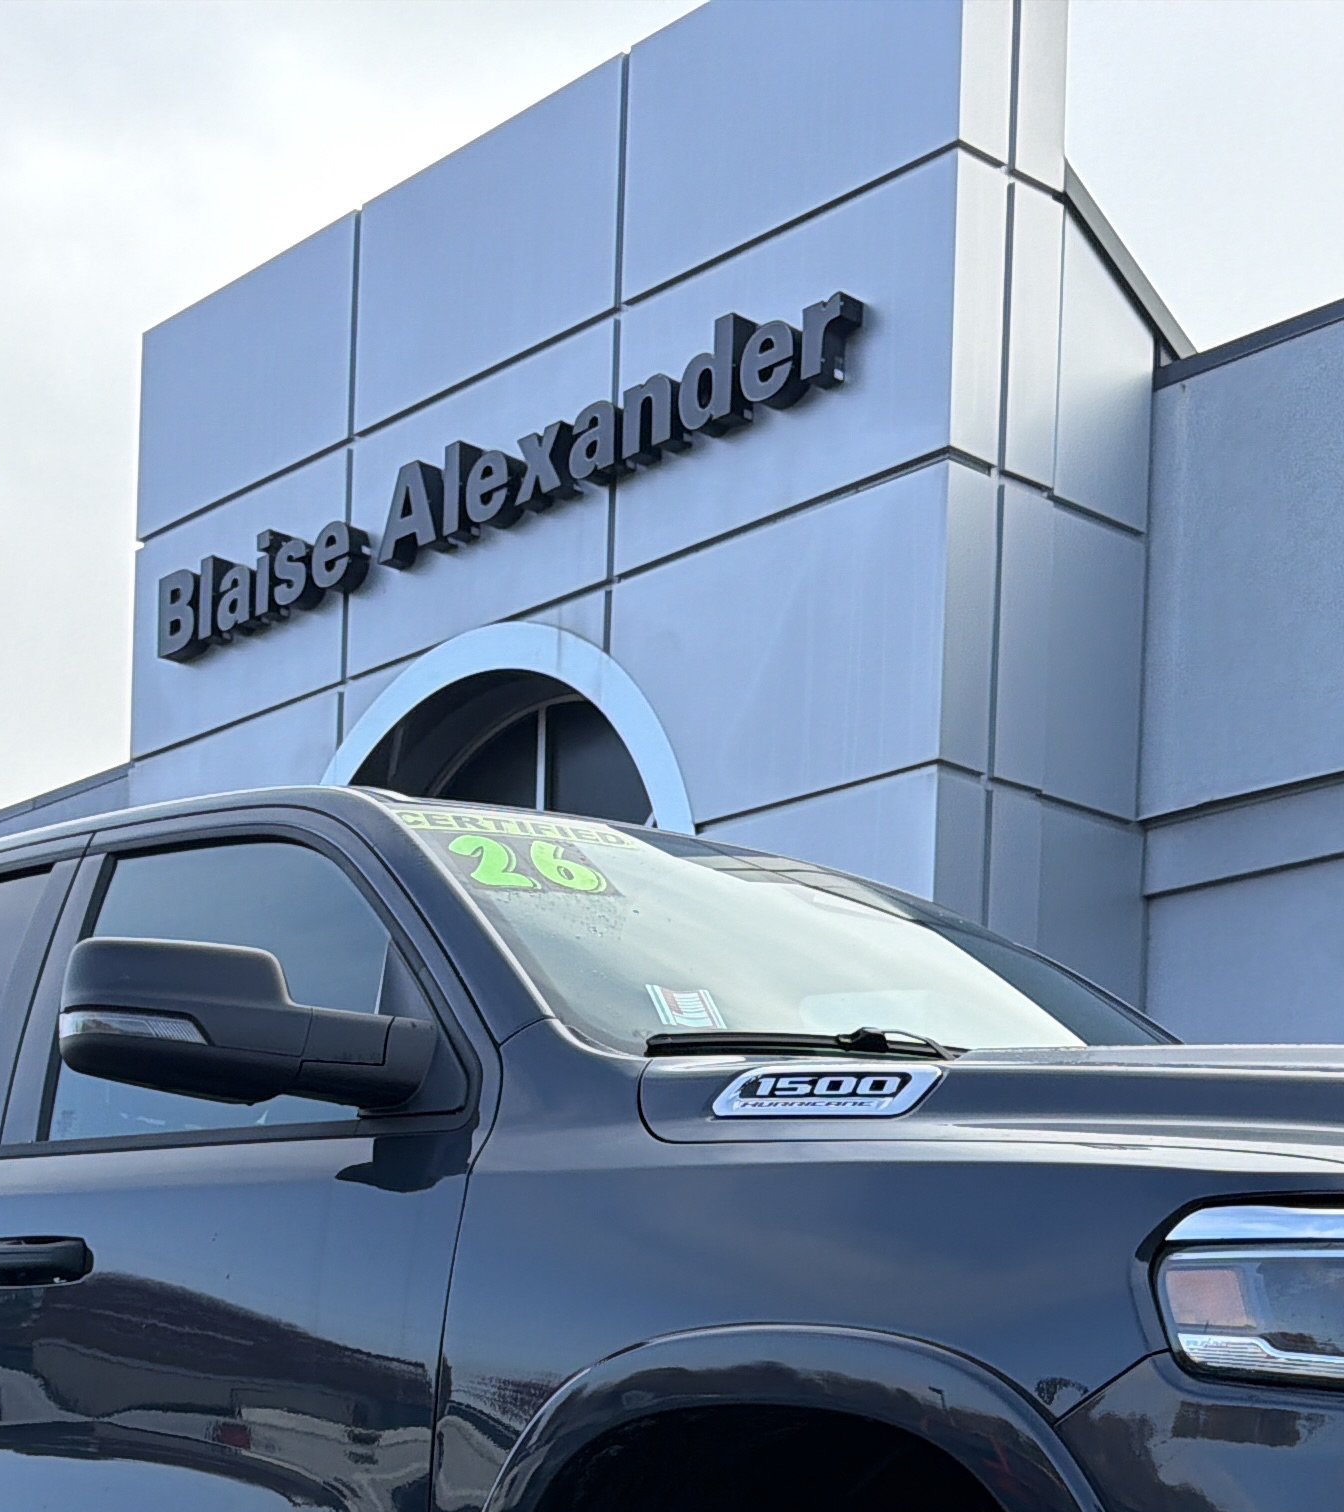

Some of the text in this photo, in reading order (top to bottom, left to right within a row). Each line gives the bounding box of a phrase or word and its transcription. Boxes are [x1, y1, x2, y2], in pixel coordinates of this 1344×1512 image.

[158, 291, 863, 662] Blaise Alexander
[396, 811, 627, 847] CERTIFIED
[448, 834, 608, 893] 26
[739, 1099, 874, 1109] HURRICANE
[755, 1076, 902, 1096] 1500
